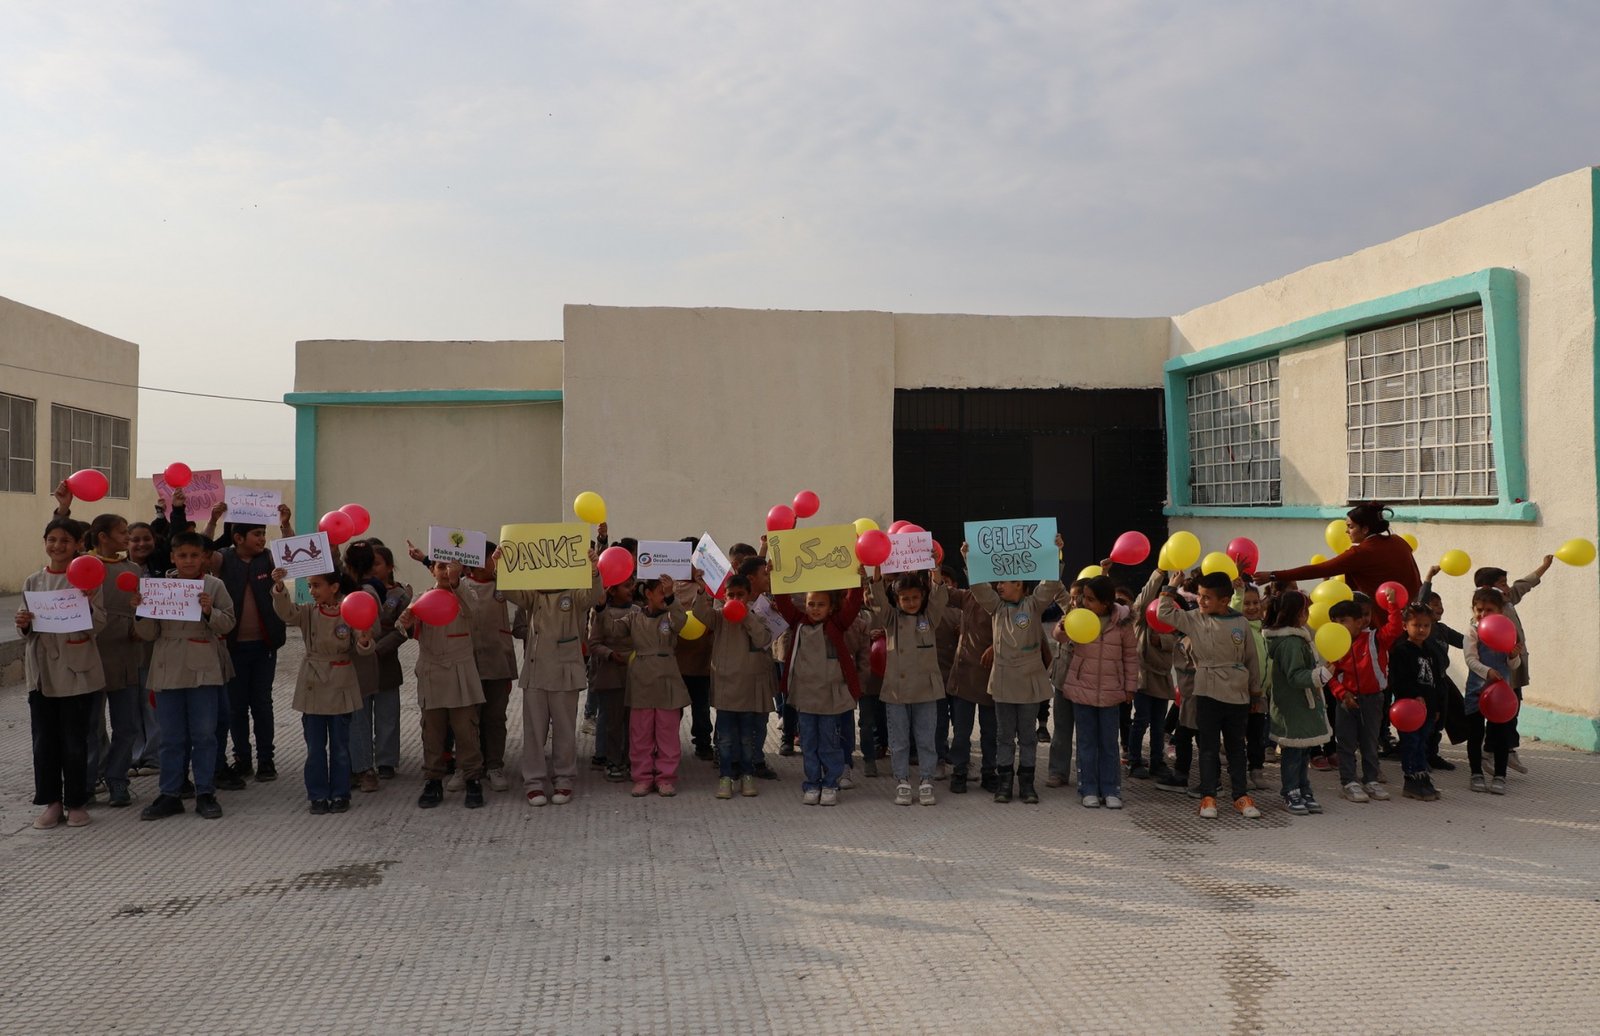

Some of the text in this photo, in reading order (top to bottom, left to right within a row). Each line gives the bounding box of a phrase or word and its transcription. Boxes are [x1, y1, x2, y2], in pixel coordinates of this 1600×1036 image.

[155, 473, 219, 497] TNK
[978, 524, 1042, 554] GELEK
[433, 548, 480, 560] Make Rojava
[433, 553, 480, 566] Green Again
[500, 535, 586, 573] DANKE
[991, 551, 1037, 576] SPAS
[144, 579, 160, 589] Em
[183, 589, 195, 598] bo
[150, 606, 185, 617] daran
